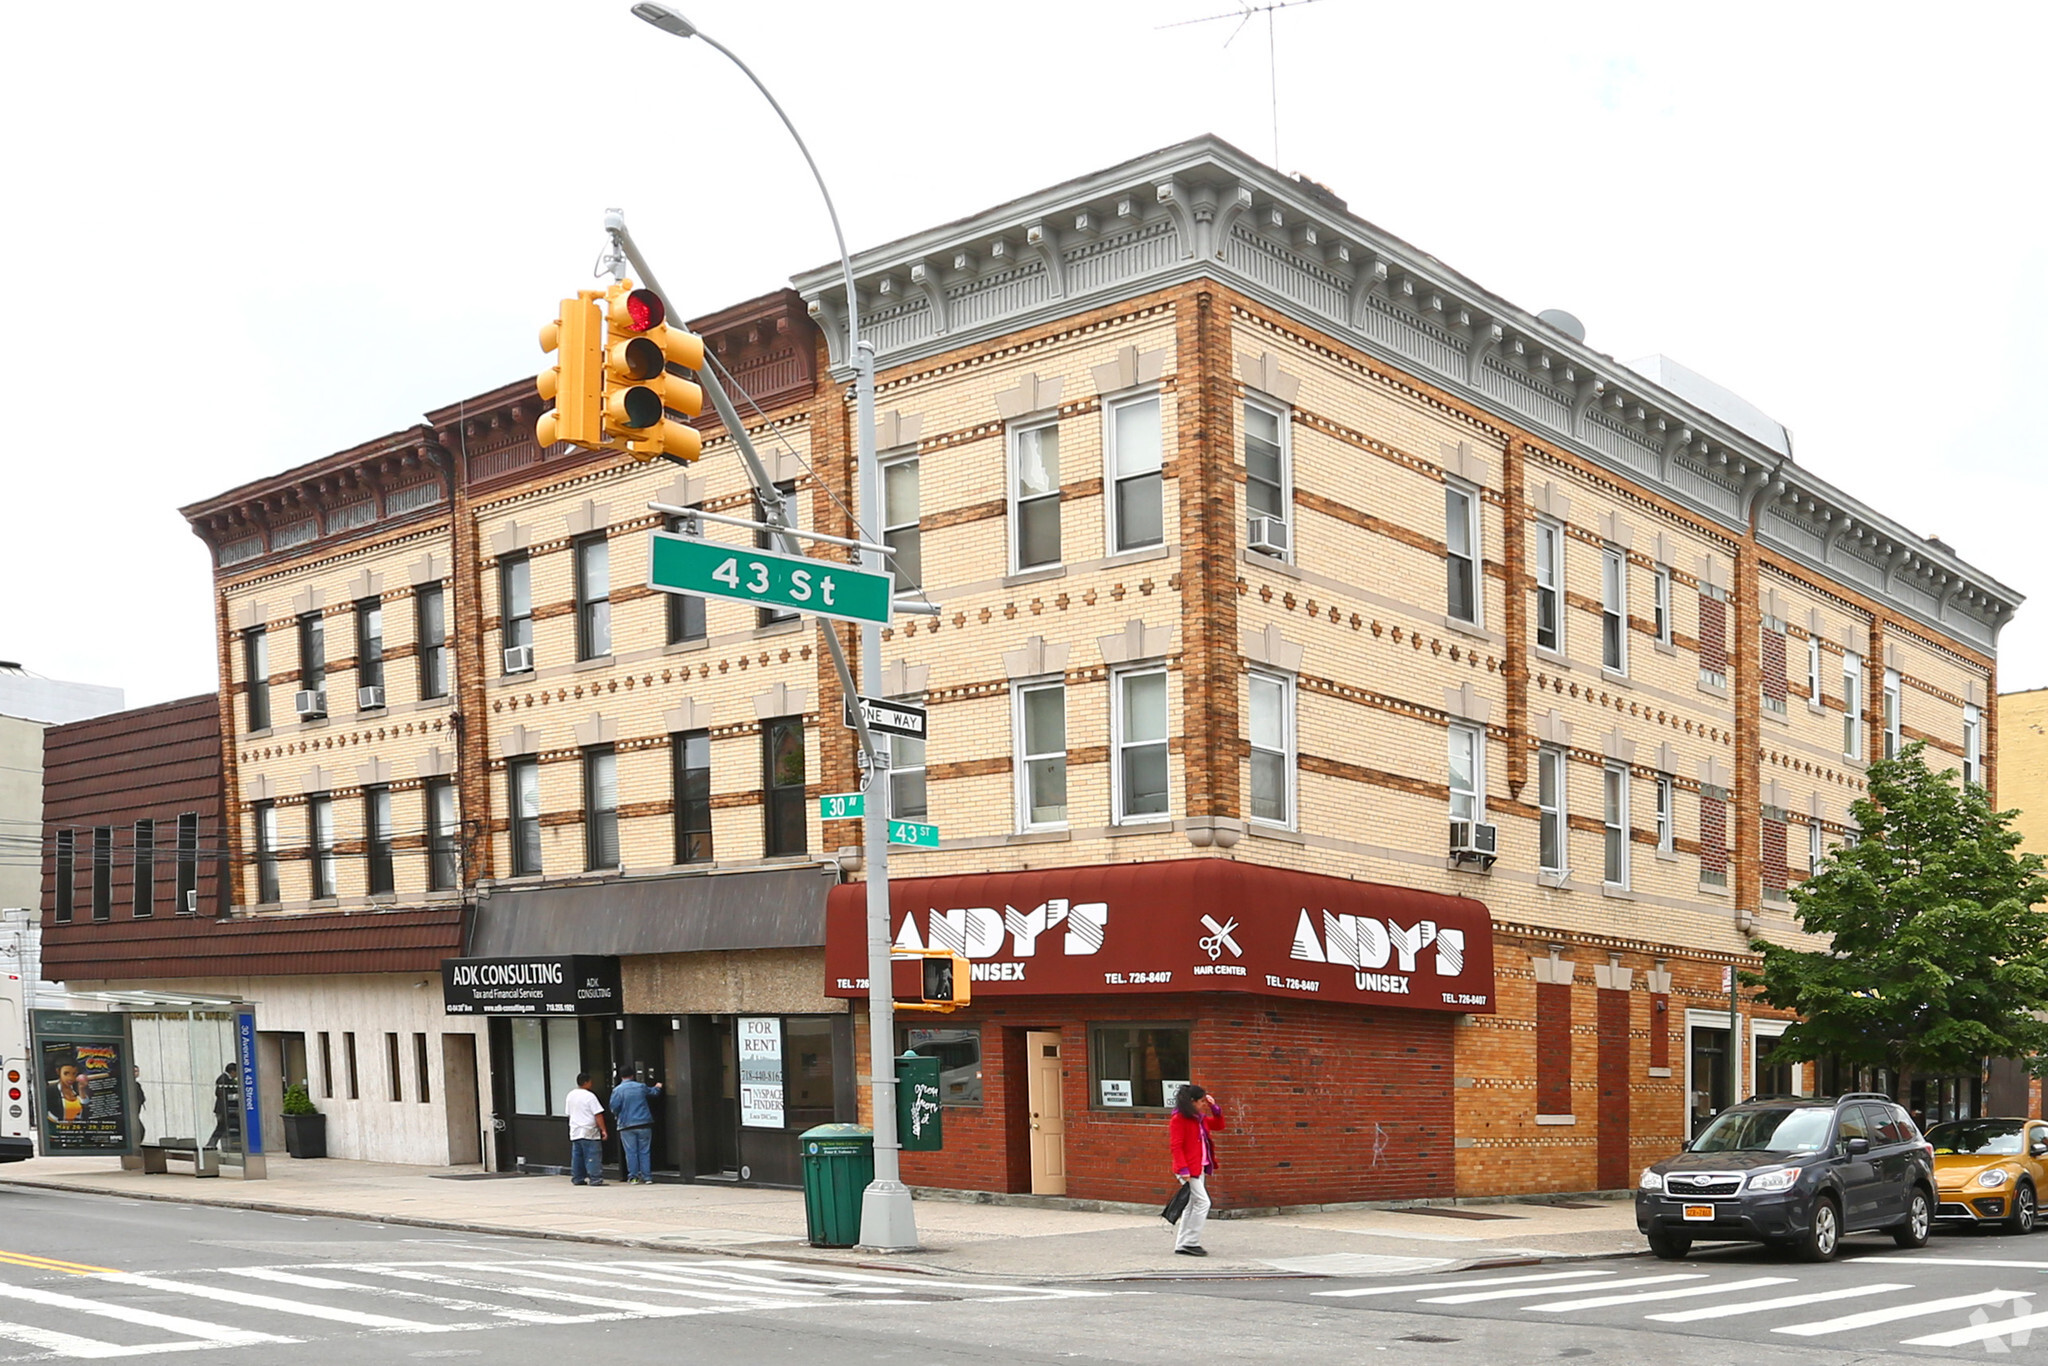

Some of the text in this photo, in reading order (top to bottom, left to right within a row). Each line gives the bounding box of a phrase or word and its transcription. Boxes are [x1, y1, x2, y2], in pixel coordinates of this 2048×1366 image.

[711, 557, 836, 606] 43 St
[861, 706, 918, 729] ONE WAY
[829, 797, 846, 817] 30
[895, 823, 931, 844] 43 ST
[889, 898, 1108, 960] ANDY'S
[1289, 907, 1466, 977] ANDY'S
[453, 963, 563, 986] ADK CONSULTING
[1193, 965, 1247, 977] HAIR CENTER
[586, 978, 599, 988] ADK
[837, 978, 854, 989] TEL.
[1105, 971, 1172, 985] TEL. 726-8407
[1265, 975, 1320, 992] TEL. 726-8407
[1355, 971, 1410, 995] UNISEX
[472, 987, 544, 999] Tax and Financial Services
[577, 988, 612, 1000] CONSULTING
[1441, 993, 1487, 1006] TEL. 726-8407
[240, 1025, 249, 1035] 30
[748, 1021, 772, 1034] FOR
[242, 1037, 250, 1065] Avenue
[745, 1039, 777, 1052] RENT
[244, 1075, 253, 1085] 43
[1111, 1083, 1120, 1091] NO
[245, 1087, 254, 1110] Street
[753, 1100, 784, 1111] FINDERS
